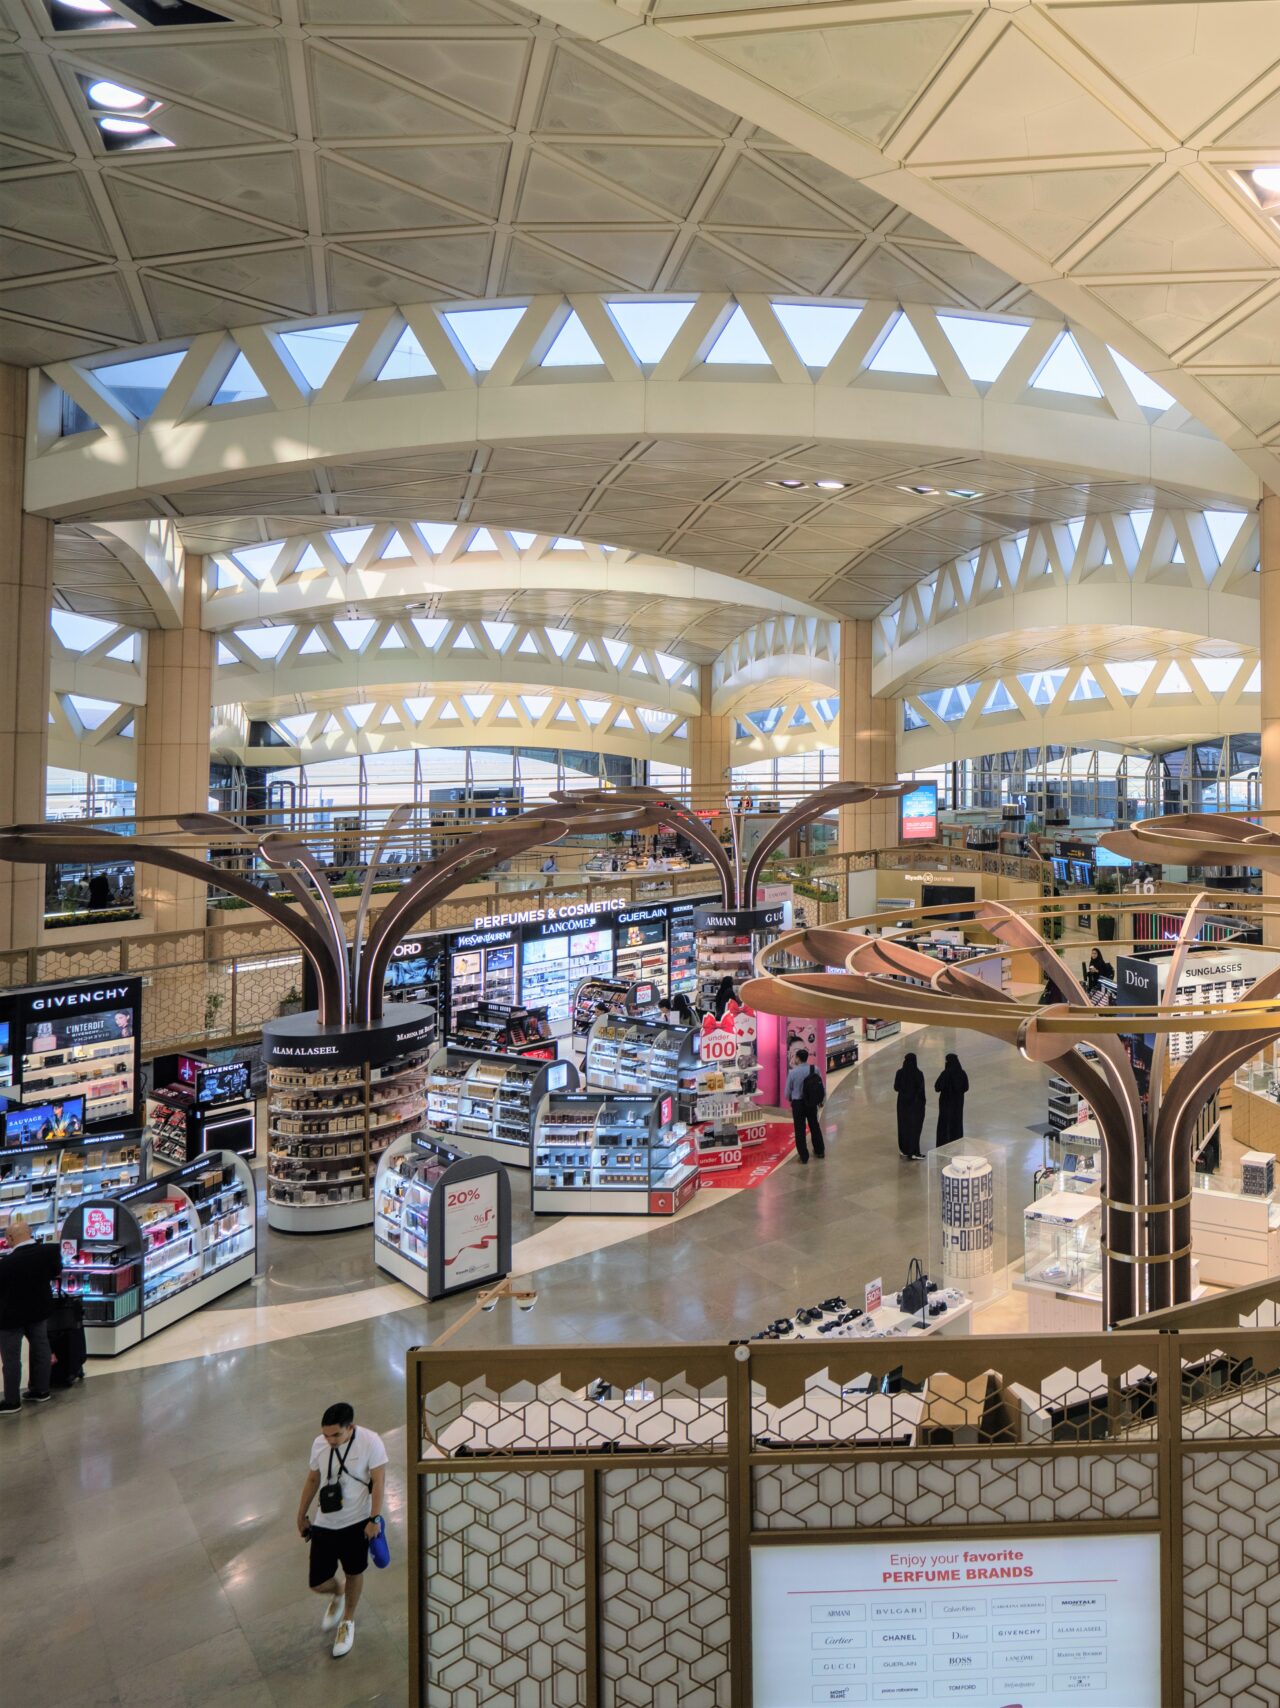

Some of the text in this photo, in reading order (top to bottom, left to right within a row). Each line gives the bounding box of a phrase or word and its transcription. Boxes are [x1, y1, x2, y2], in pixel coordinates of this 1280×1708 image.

[1132, 878, 1155, 895] 16
[474, 898, 626, 929] PERFUMES & COSMETICS
[618, 908, 667, 923] GUERLAIN
[765, 910, 785, 923] GUC
[706, 916, 737, 926] ARMANI
[393, 943, 421, 957] ORD
[1185, 963, 1243, 978] SUNGLASSES
[1124, 969, 1150, 989] Dior
[32, 987, 129, 1010] GIVENCHY
[66, 1020, 105, 1034] L'INTERDIT
[708, 1033, 730, 1041] under
[273, 1046, 339, 1056] ALAM ALASEEL
[703, 1041, 735, 1059] 100
[204, 1063, 244, 1075] GIVENCHY
[745, 1126, 767, 1140] 100
[719, 1150, 741, 1163] 100
[447, 1188, 480, 1207] 20%
[890, 1550, 1023, 1567] Enjoy your favorite
[882, 1566, 1033, 1583] PERFUME BRANDS
[827, 1609, 851, 1617] ARMANI
[998, 1629, 1041, 1637] GIVENCHY
[825, 1636, 853, 1645] Cartier
[949, 1656, 972, 1665] BOSS
